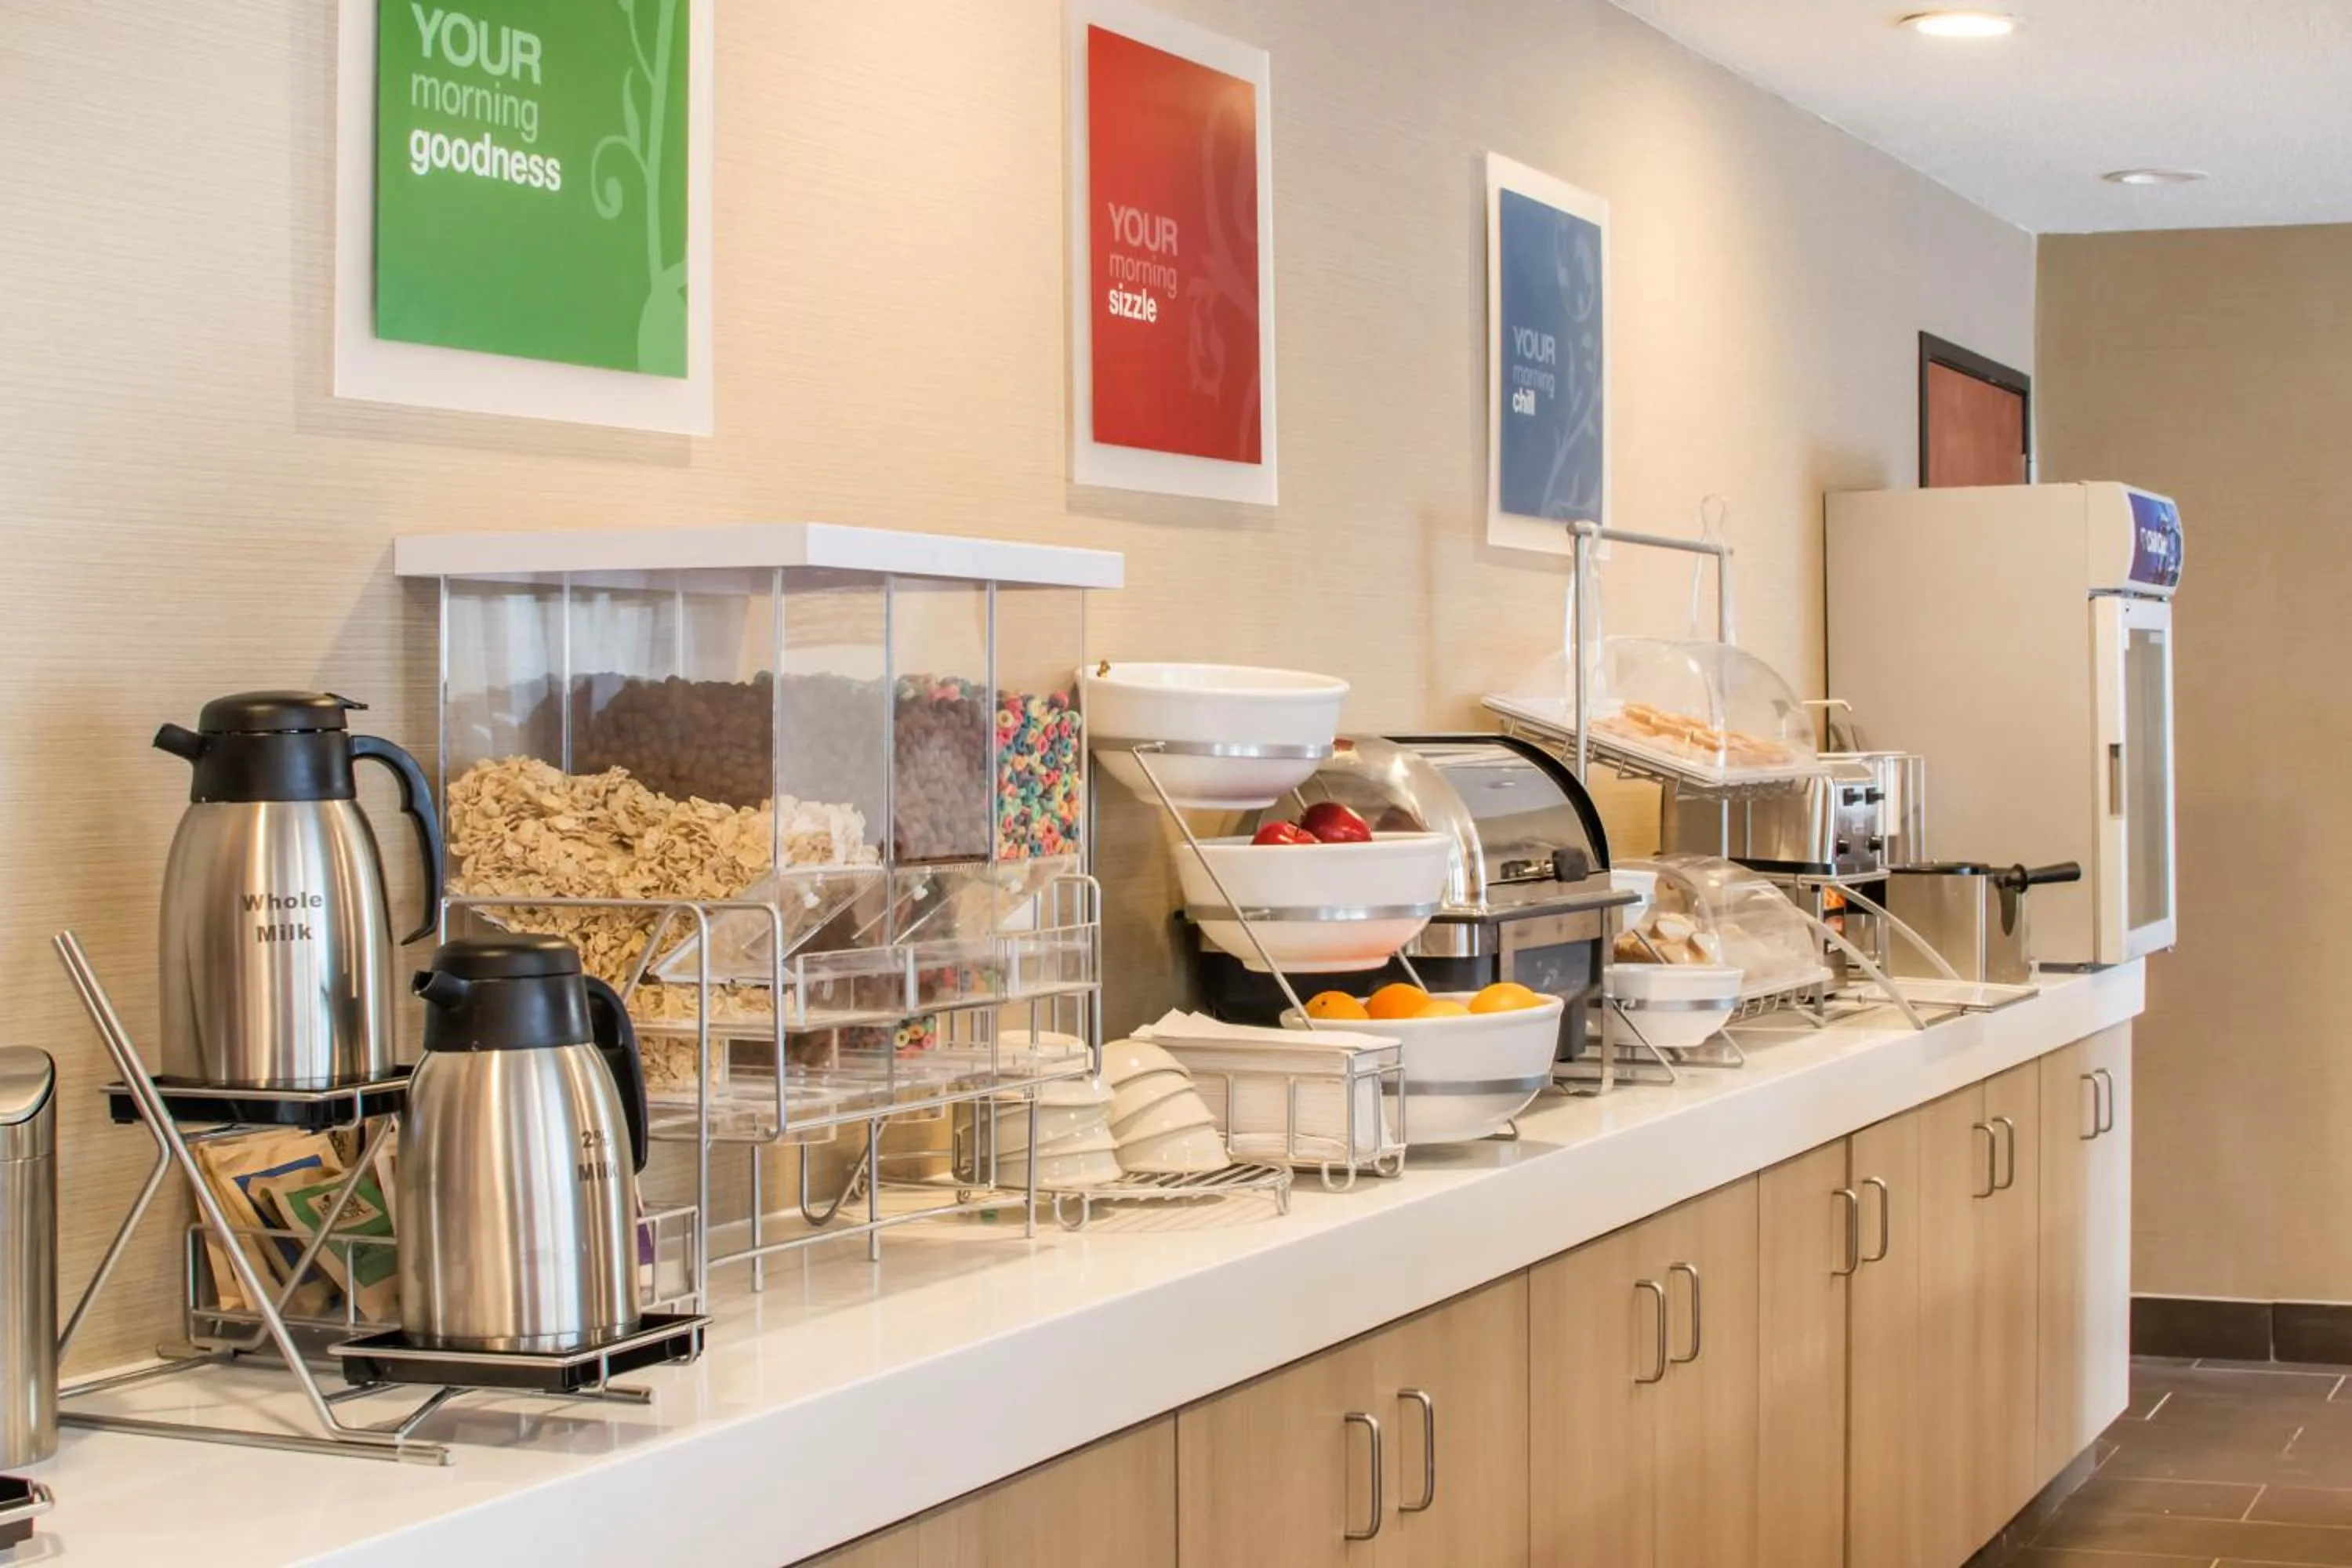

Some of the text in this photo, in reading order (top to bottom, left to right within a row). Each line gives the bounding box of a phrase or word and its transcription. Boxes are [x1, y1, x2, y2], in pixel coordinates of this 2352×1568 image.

[411, 2, 542, 84] YOUR
[411, 72, 538, 143] morning
[410, 129, 561, 191] goodness
[1108, 201, 1178, 256] YOUR
[1109, 252, 1178, 299] morning
[1108, 282, 1157, 323] sizzle
[1512, 325, 1555, 365] YOUR
[240, 891, 323, 912] Whole
[256, 923, 312, 942] Milk
